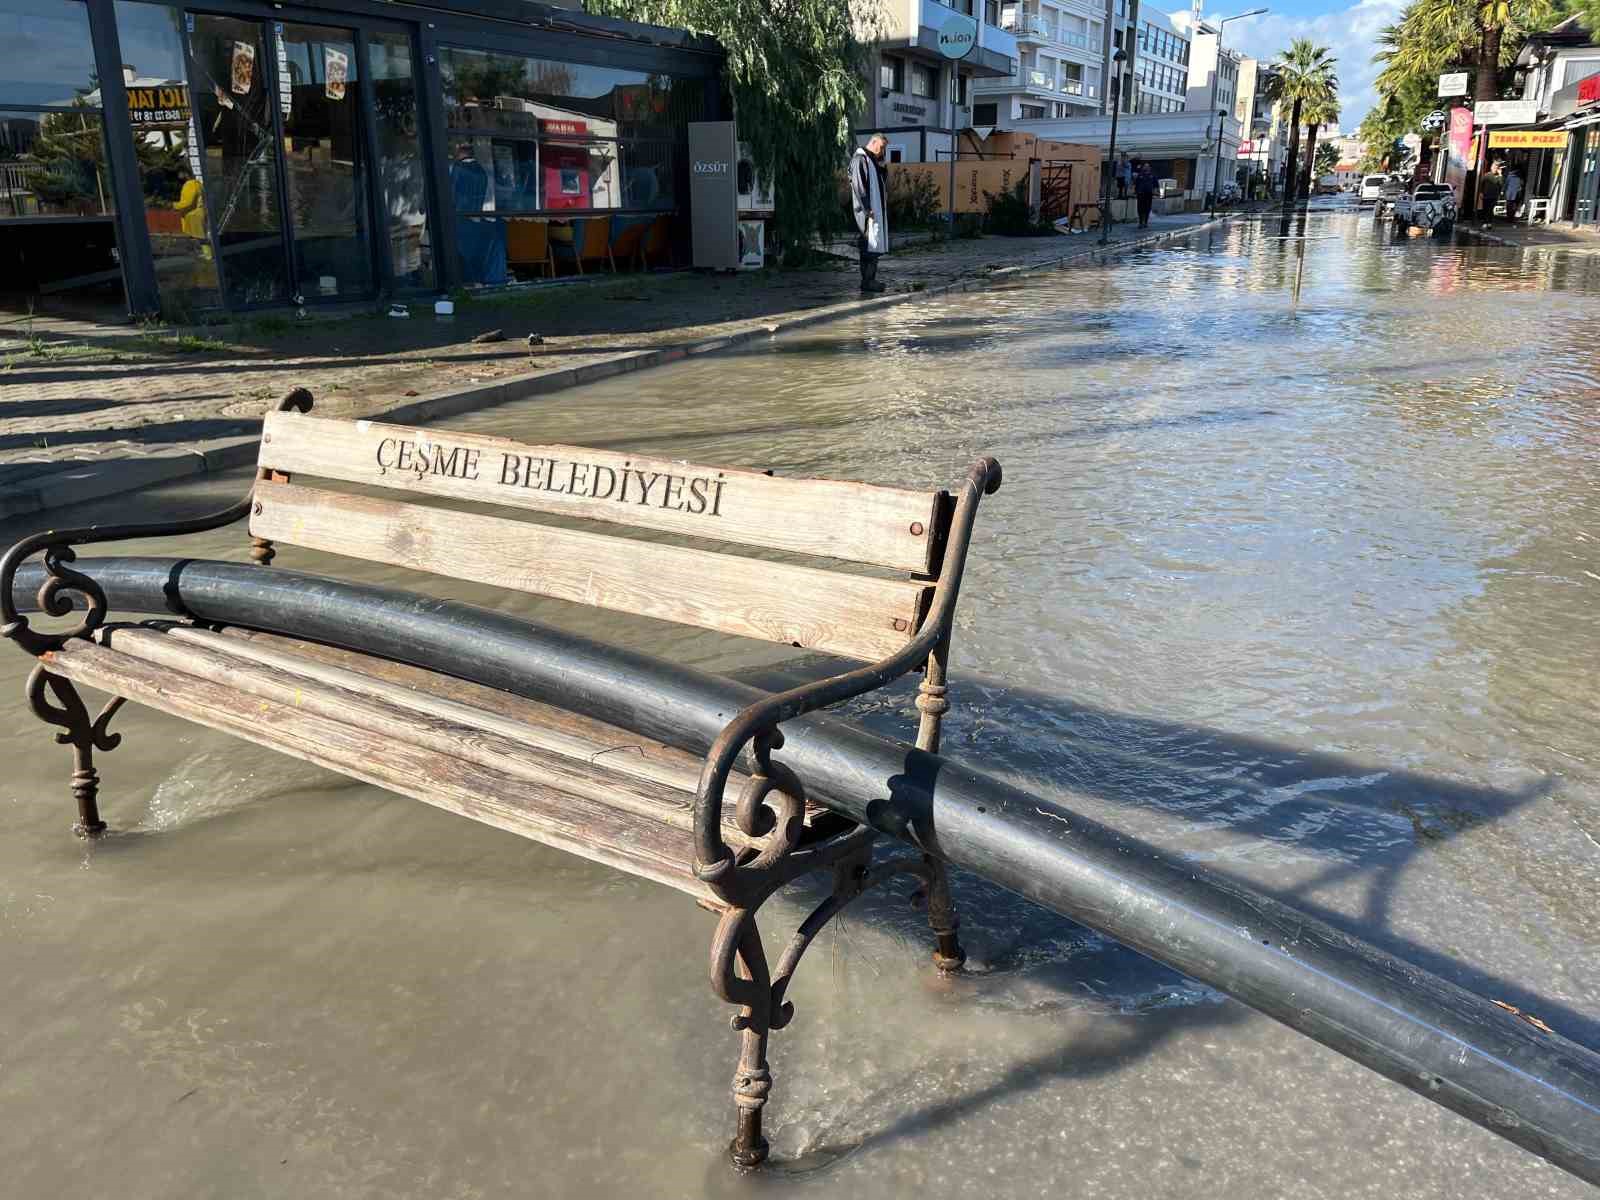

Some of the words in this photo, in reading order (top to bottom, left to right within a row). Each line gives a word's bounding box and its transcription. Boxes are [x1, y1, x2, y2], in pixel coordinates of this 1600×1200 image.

[693, 160, 729, 173] ÖZSÜT
[375, 437, 481, 481] ÇEŞME
[497, 452, 728, 517] BELEDİYESİ
